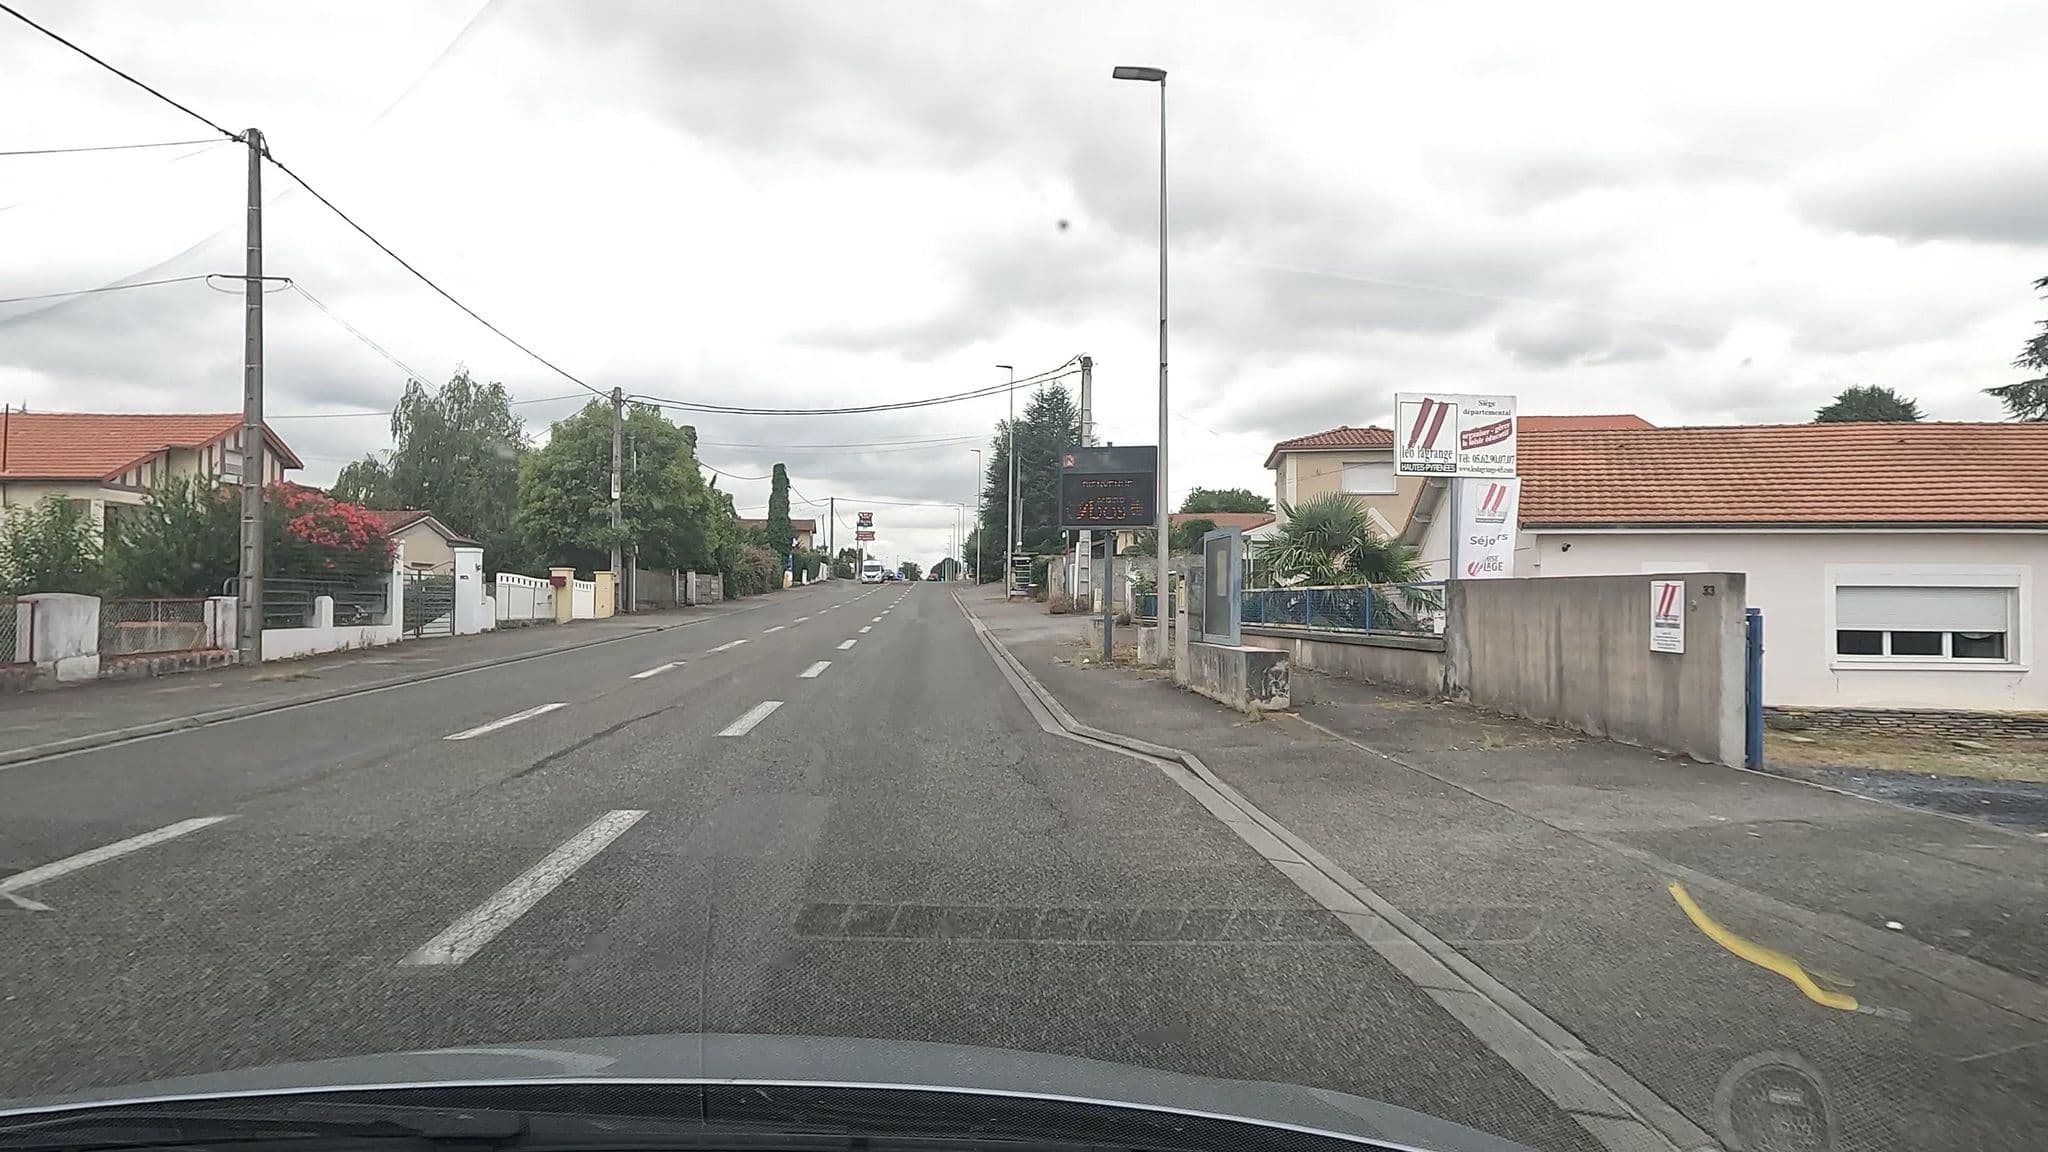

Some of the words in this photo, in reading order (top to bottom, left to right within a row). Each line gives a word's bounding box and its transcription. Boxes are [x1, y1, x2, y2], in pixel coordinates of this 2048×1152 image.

[1463, 408, 1511, 416] départemental
[1418, 445, 1453, 463] lagrange
[1702, 585, 1715, 596] 33
